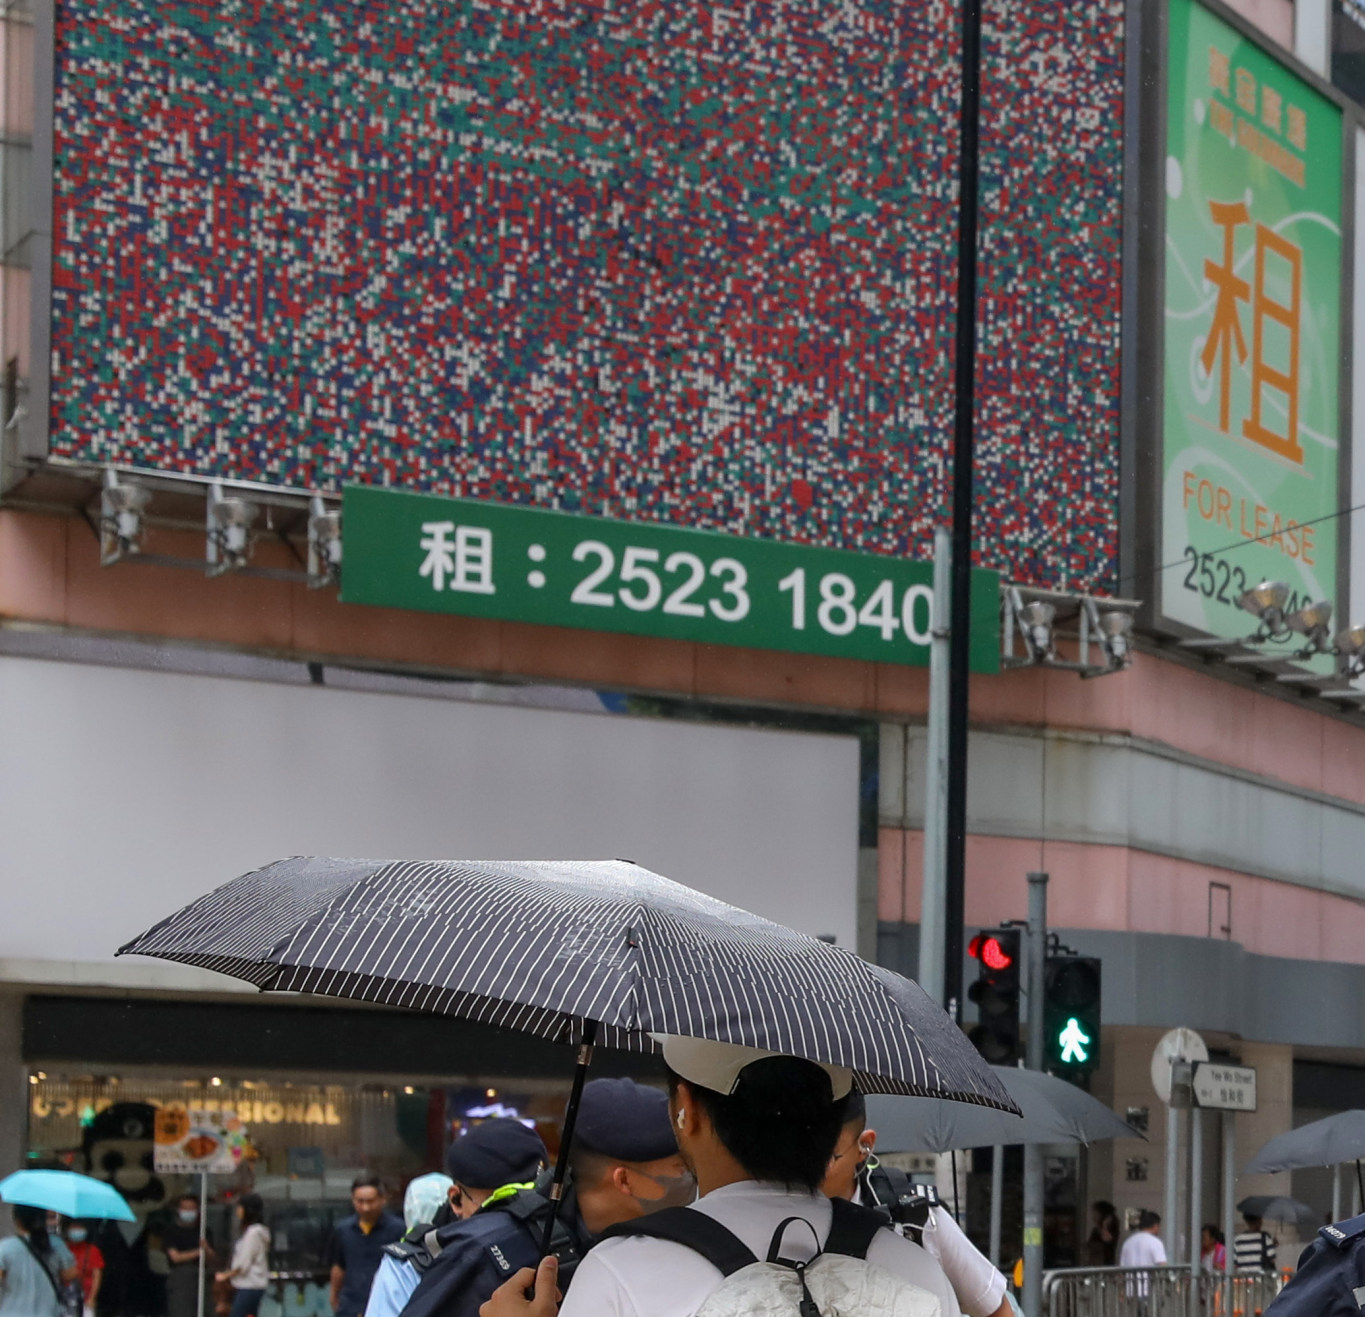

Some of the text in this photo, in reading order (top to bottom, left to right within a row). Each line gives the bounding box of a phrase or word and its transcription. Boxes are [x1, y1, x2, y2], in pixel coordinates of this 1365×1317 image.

[1200, 199, 1305, 468] 租
[1183, 471, 1315, 566] FOR LEASE
[570, 539, 751, 623] 2523
[778, 567, 934, 647] 1840
[1184, 546, 1246, 611] 2523
[1234, 1072, 1253, 1084] Street
